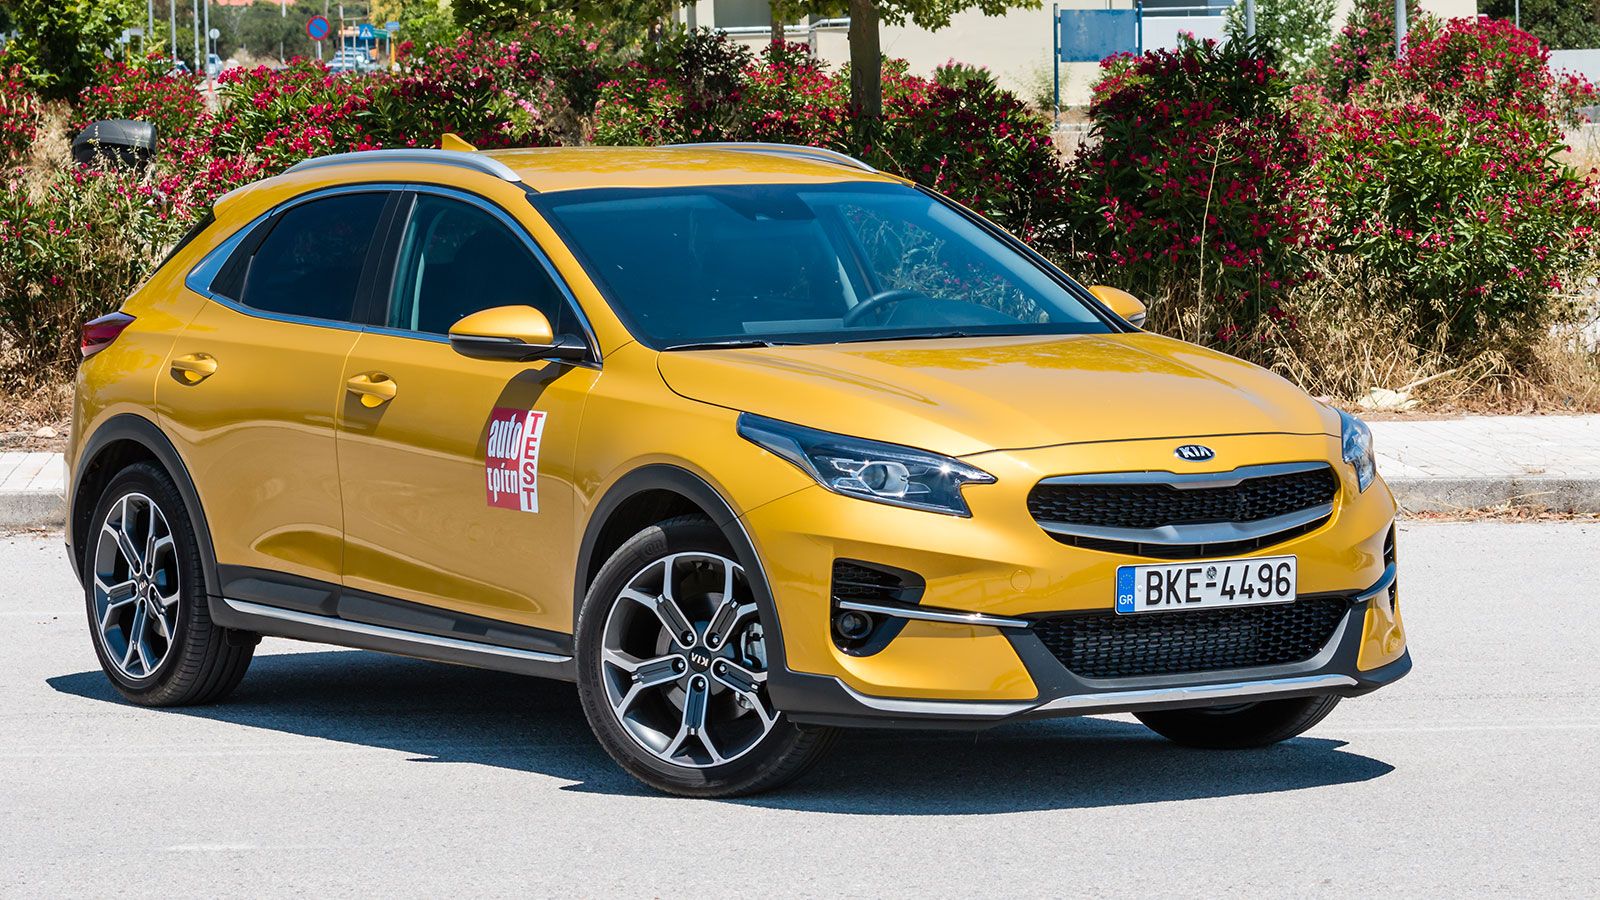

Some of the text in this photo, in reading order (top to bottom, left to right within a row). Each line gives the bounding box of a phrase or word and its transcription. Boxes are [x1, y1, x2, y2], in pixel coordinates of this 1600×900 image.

[487, 413, 522, 461] auto
[522, 412, 543, 510] TEST
[1179, 446, 1212, 458] KIA
[1146, 562, 1291, 606] BKE-4496
[1119, 594, 1133, 605] GR
[691, 652, 709, 667] KIA
